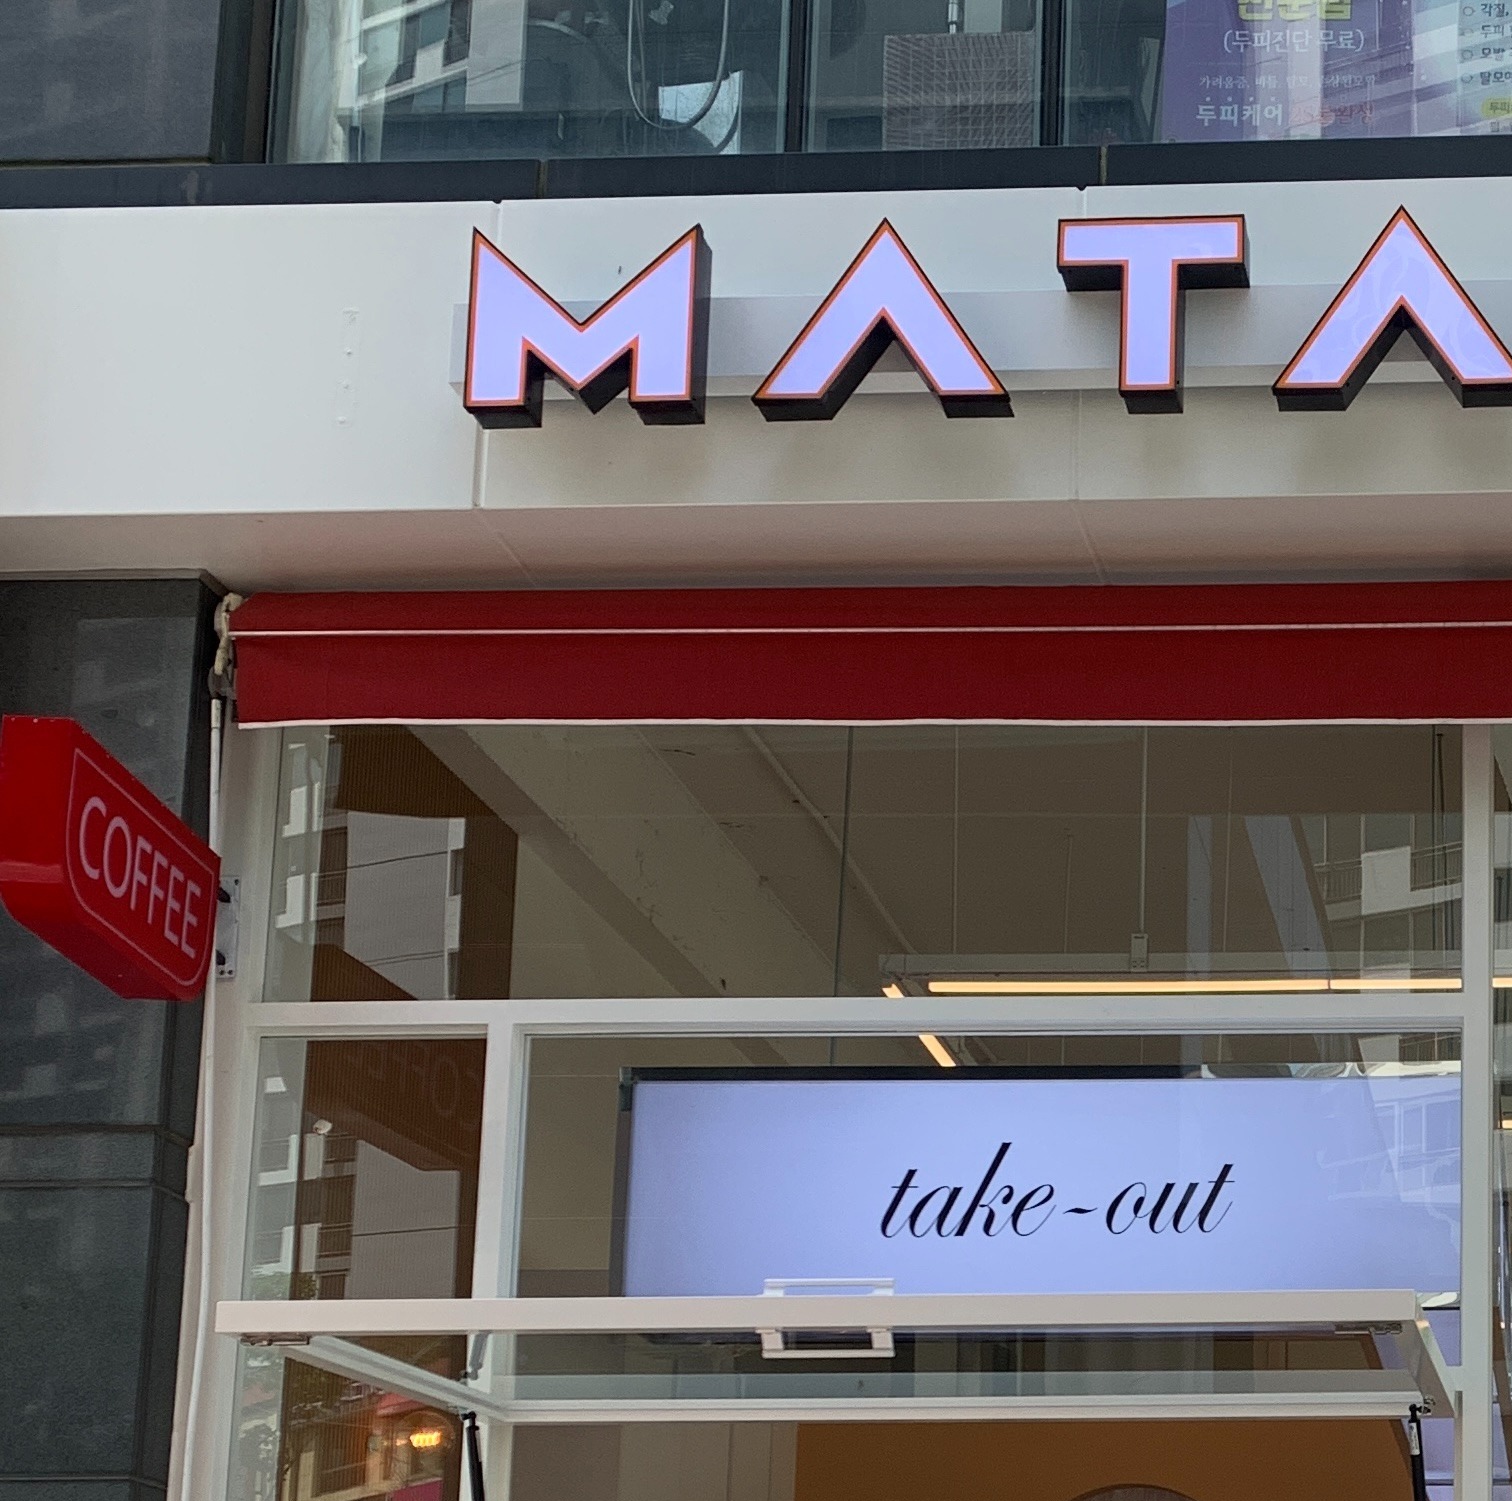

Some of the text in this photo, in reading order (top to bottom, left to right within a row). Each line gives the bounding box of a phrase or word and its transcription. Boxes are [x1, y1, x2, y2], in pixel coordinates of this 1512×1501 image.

[1223, 29, 1364, 53] (두피진단 무료)
[1480, 25, 1504, 38] 두피
[1196, 103, 1283, 127] 두피케어
[79, 796, 202, 960] COFFEE
[880, 1141, 1236, 1239] take-out
